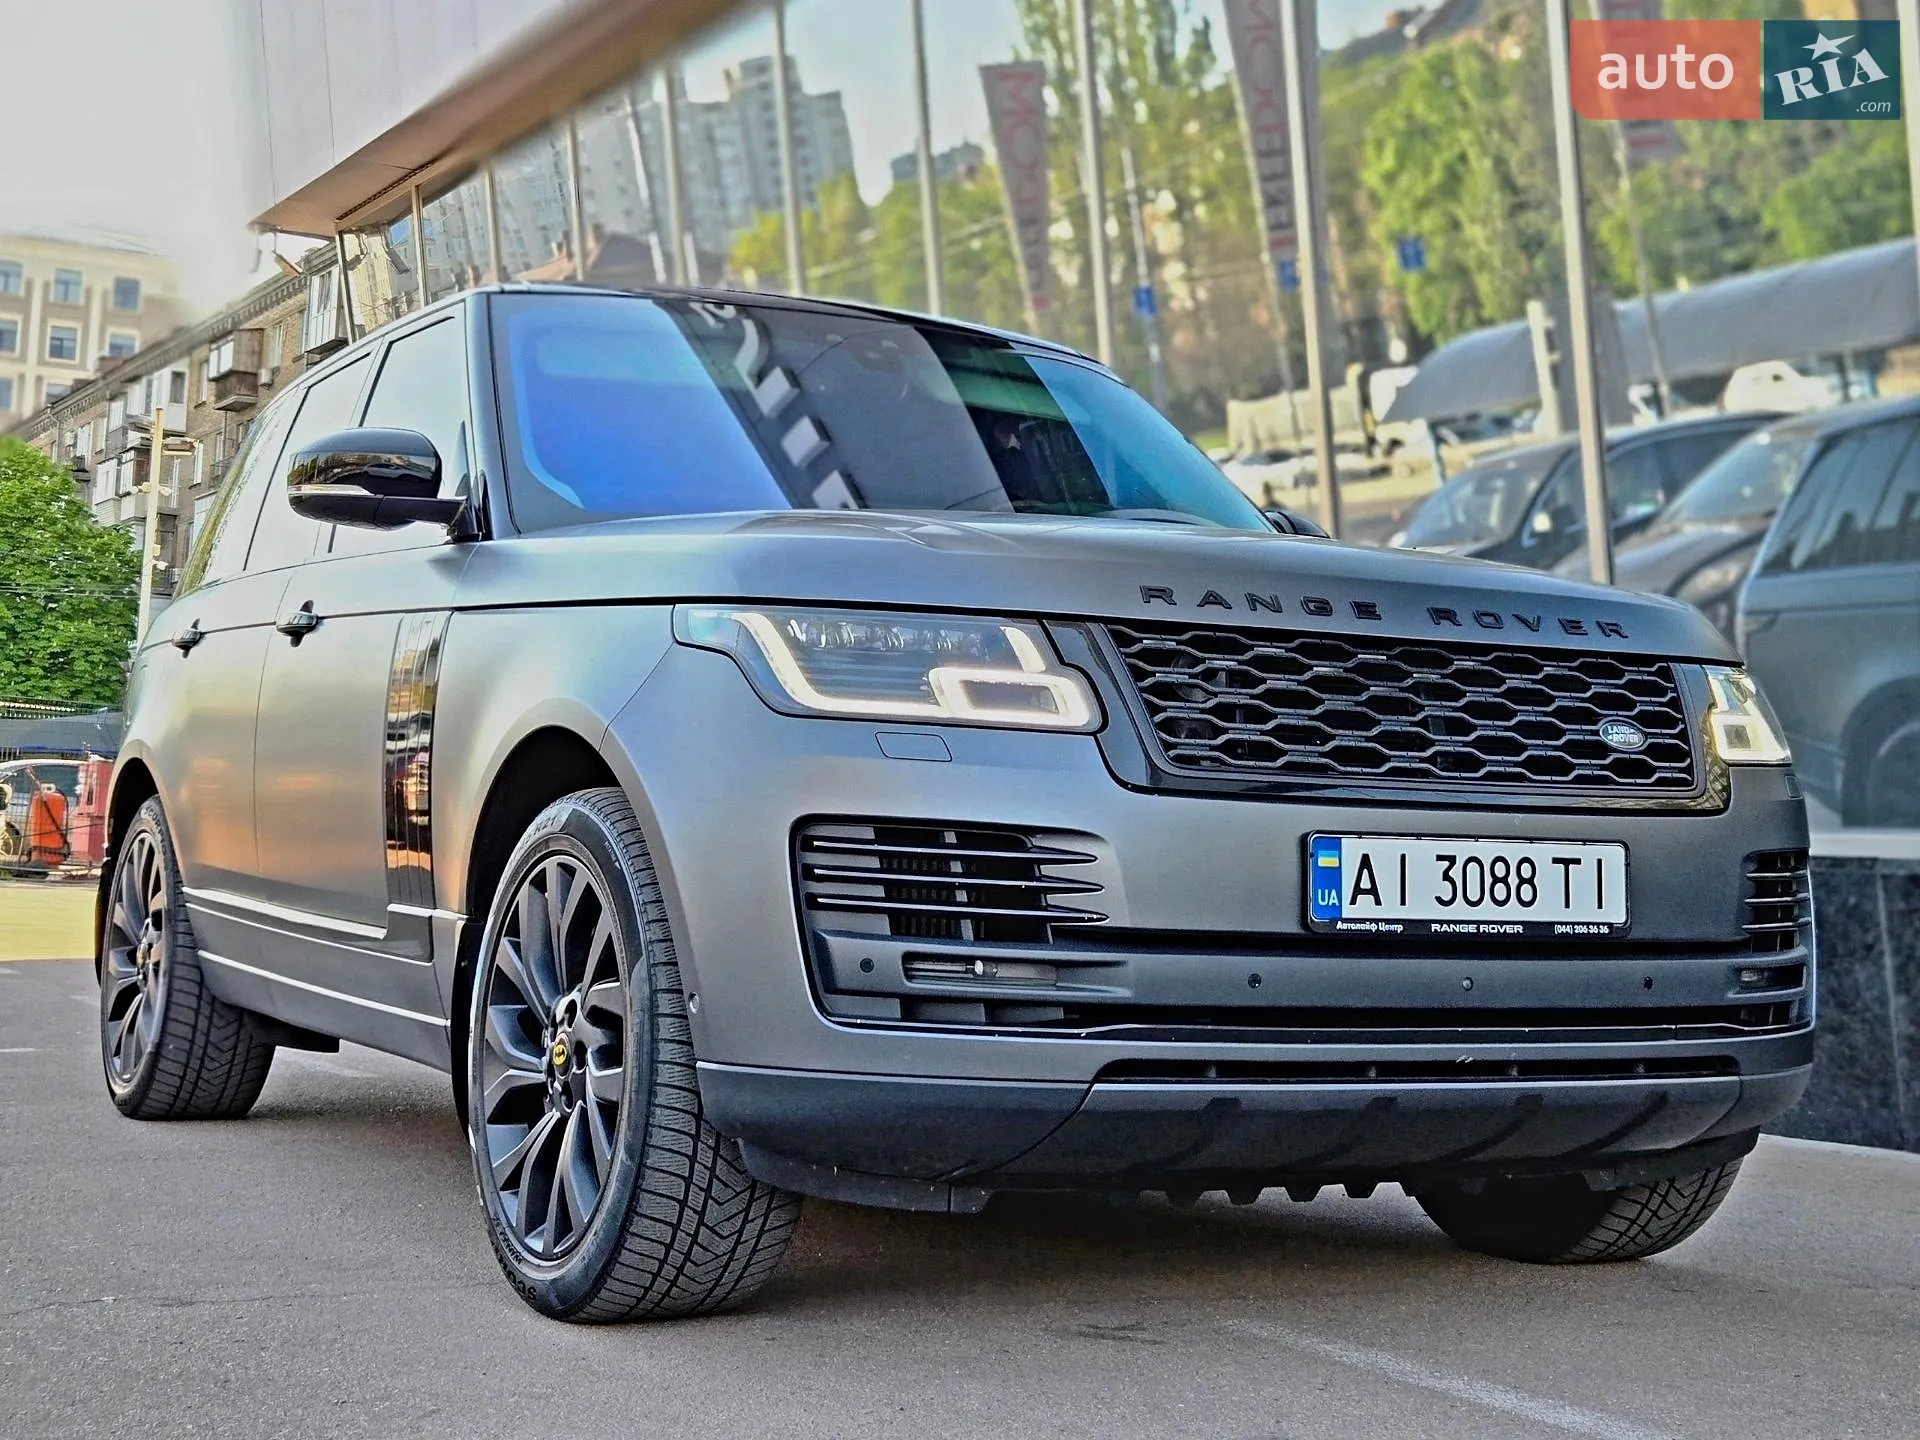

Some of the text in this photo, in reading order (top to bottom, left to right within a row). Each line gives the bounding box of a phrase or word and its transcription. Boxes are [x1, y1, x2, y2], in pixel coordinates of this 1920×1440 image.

[1140, 584, 1630, 639] RANGE ROVER
[1434, 854, 1538, 909] 3088
[1317, 888, 1340, 907] UA
[1431, 923, 1524, 934] RANGE ROVER
[1554, 924, 1573, 935] (044)
